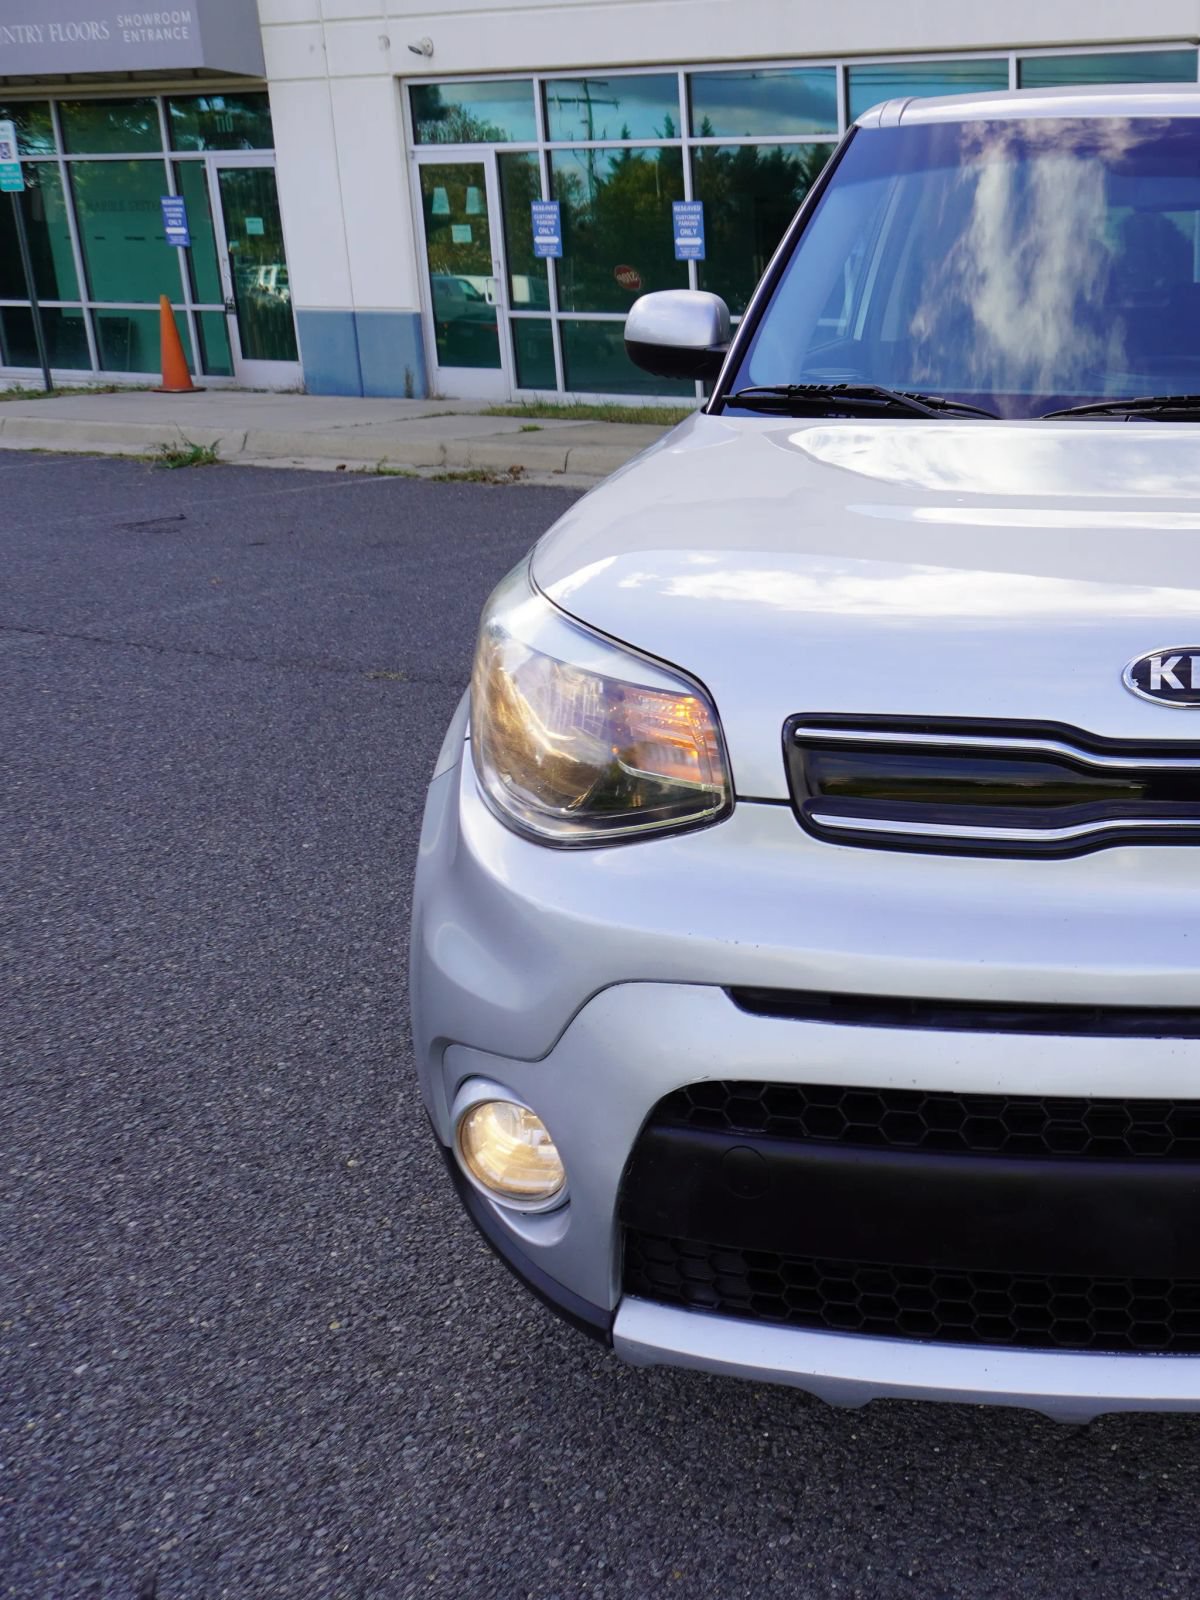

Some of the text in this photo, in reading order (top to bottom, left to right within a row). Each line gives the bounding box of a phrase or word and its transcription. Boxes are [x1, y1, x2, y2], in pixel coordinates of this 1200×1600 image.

[117, 10, 191, 28] SHOWROOM
[0, 20, 110, 44] NTRY FLOORS
[123, 26, 190, 43] ENTRANCE
[673, 204, 701, 212] RESERVED
[538, 227, 554, 235] ONLY
[680, 228, 697, 236] ONLY
